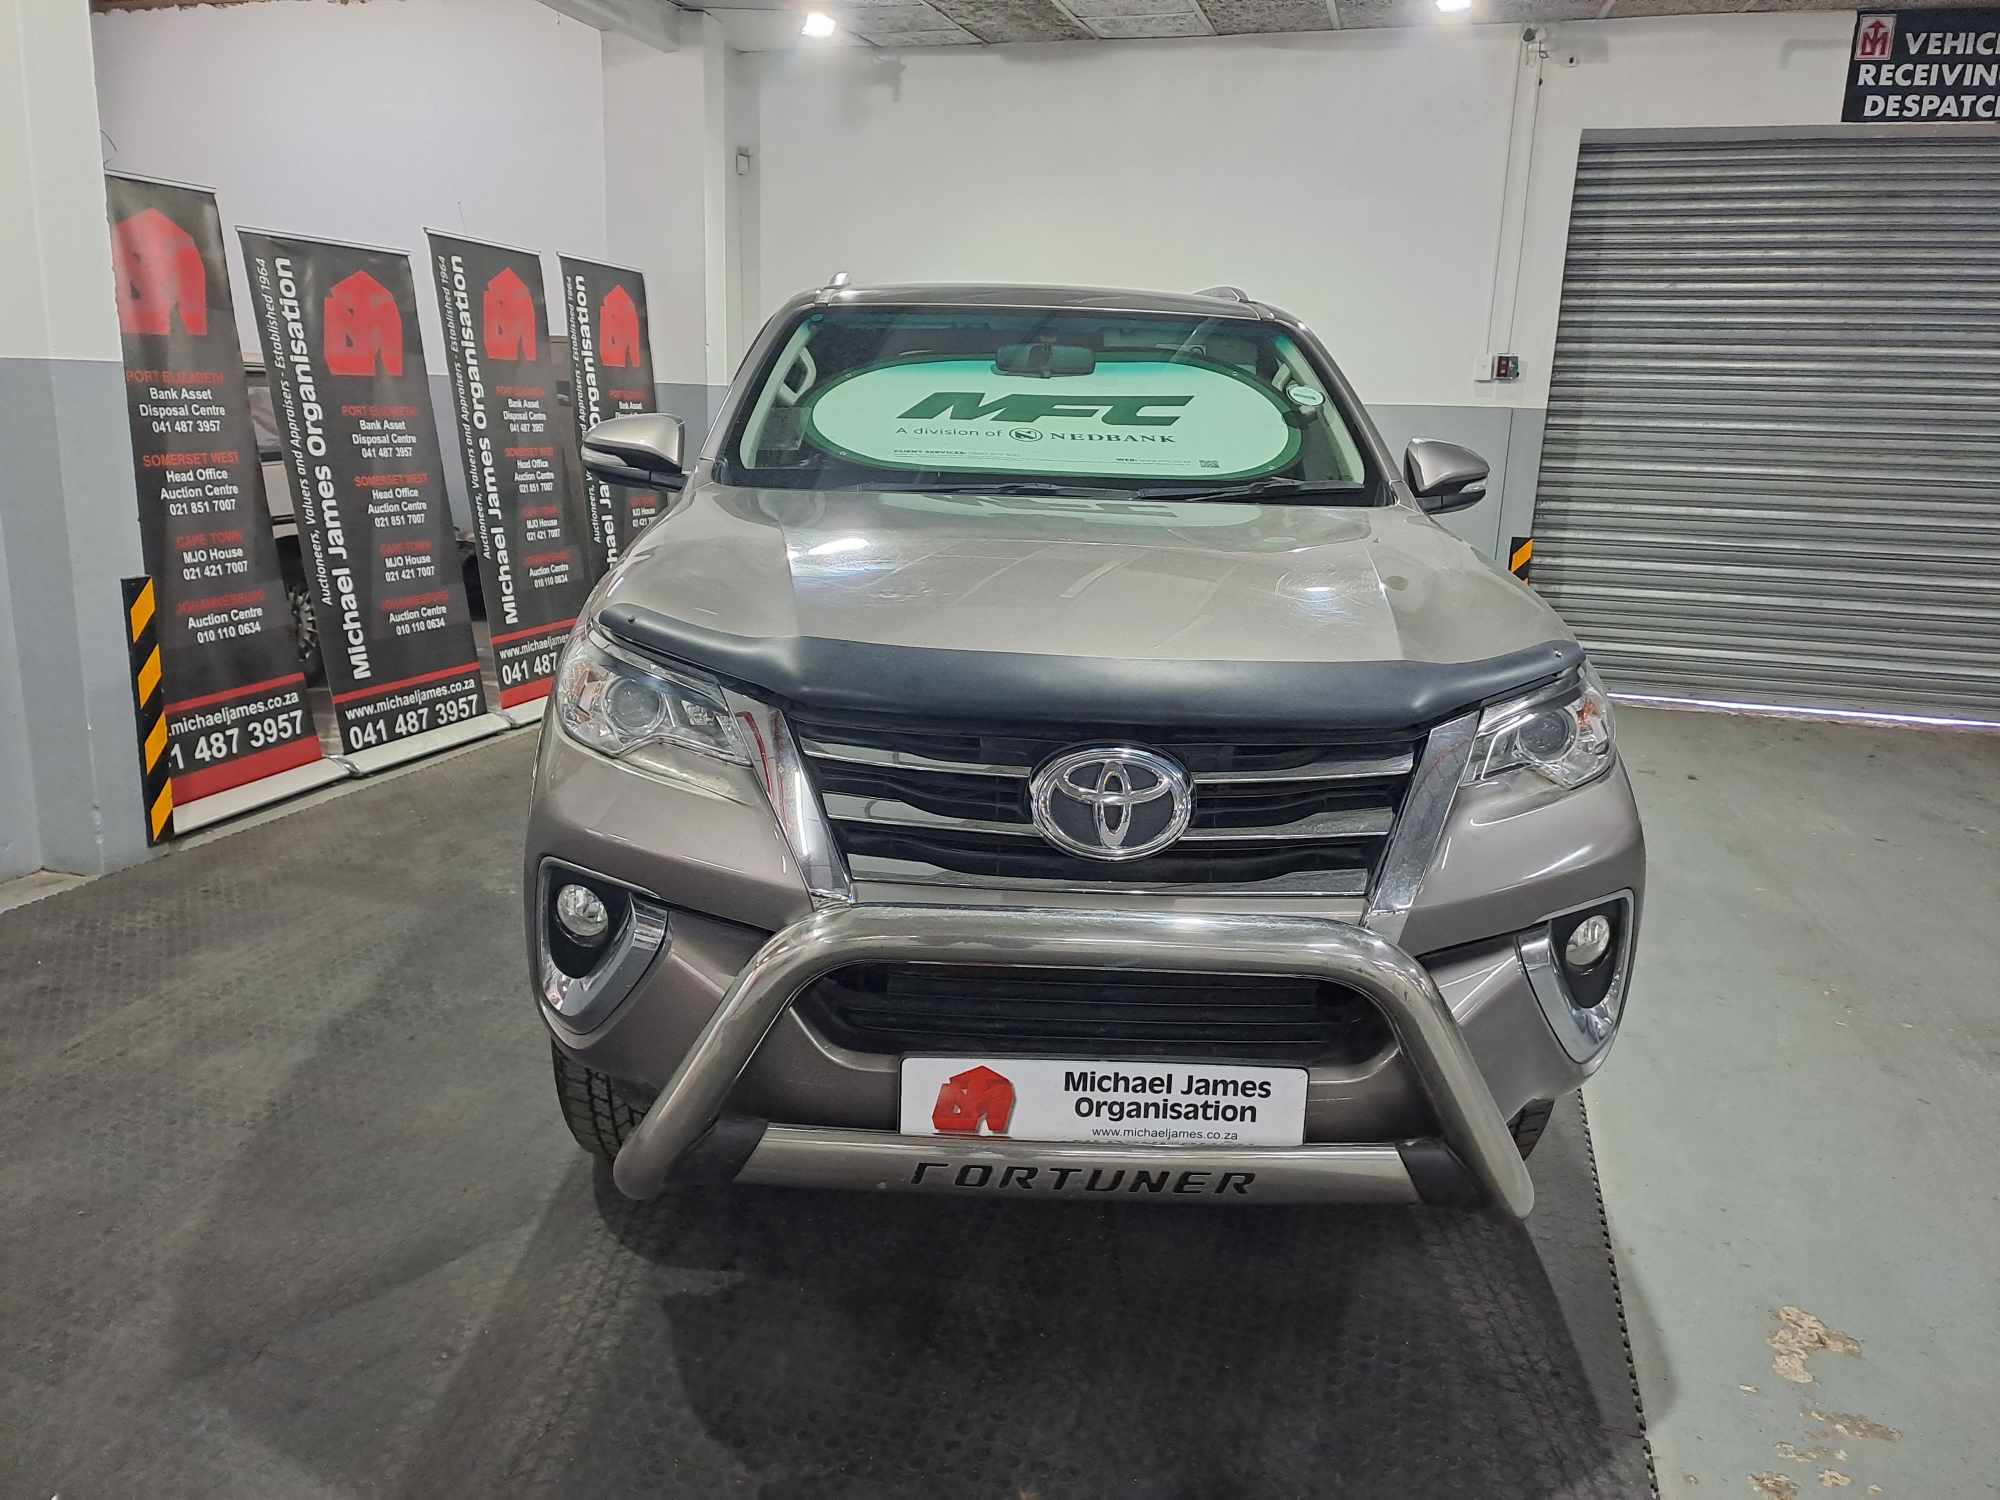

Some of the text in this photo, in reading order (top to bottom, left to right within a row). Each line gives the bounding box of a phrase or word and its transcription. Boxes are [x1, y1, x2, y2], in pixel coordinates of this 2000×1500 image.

[1905, 32, 2000, 55] VEHIC
[1857, 63, 2000, 87] RECEIVIN
[1863, 94, 2000, 118] DESPATC
[255, 257, 272, 290] 1964
[265, 294, 286, 369] Established
[149, 387, 213, 400] Bank Asset
[139, 404, 226, 419] Disposal Centre
[281, 379, 301, 450] Appraisers
[896, 392, 1194, 426] MFC
[152, 420, 221, 433] 041 487 3957
[360, 420, 406, 430] Bank Asset
[895, 427, 1177, 443] A division of NEDBANK
[352, 434, 417, 446] Disposal Centre
[295, 450, 308, 476] and
[362, 447, 377, 458] 041
[166, 468, 229, 483] Head Office
[479, 437, 502, 520] James
[160, 484, 239, 500] Auction Centre
[301, 478, 317, 525] Valuers
[372, 487, 419, 500] Head Office
[169, 499, 236, 516] 021 851 7007
[315, 465, 348, 560] James
[368, 501, 428, 514] Auction Centre
[374, 517, 390, 528] 021
[601, 514, 618, 568] hael
[183, 547, 244, 564] MJO House
[385, 554, 431, 568] MJO House
[183, 560, 249, 580] 021 421 7007
[311, 529, 333, 606] Auctioneers,
[385, 571, 400, 582] 021
[401, 568, 416, 580] 421
[491, 526, 519, 625] Michael
[188, 606, 264, 629] Auction Centre
[332, 567, 372, 680] Michael
[389, 605, 447, 624] Auction Centre
[197, 621, 262, 643] 010 110 0634
[502, 652, 558, 685] 041 487
[345, 678, 476, 721] www.michaeljames.co.za
[168, 691, 300, 737] .michaeljames.co.za
[350, 694, 479, 750] 041 487 3957
[194, 727, 240, 762] 487
[247, 709, 303, 748] 3957
[1063, 1071, 1272, 1099] Michael James
[1074, 1097, 1258, 1123] Organisation
[1092, 1127, 1238, 1141] www.michaeljames.co.za
[910, 1162, 1256, 1194] FORTUNER
